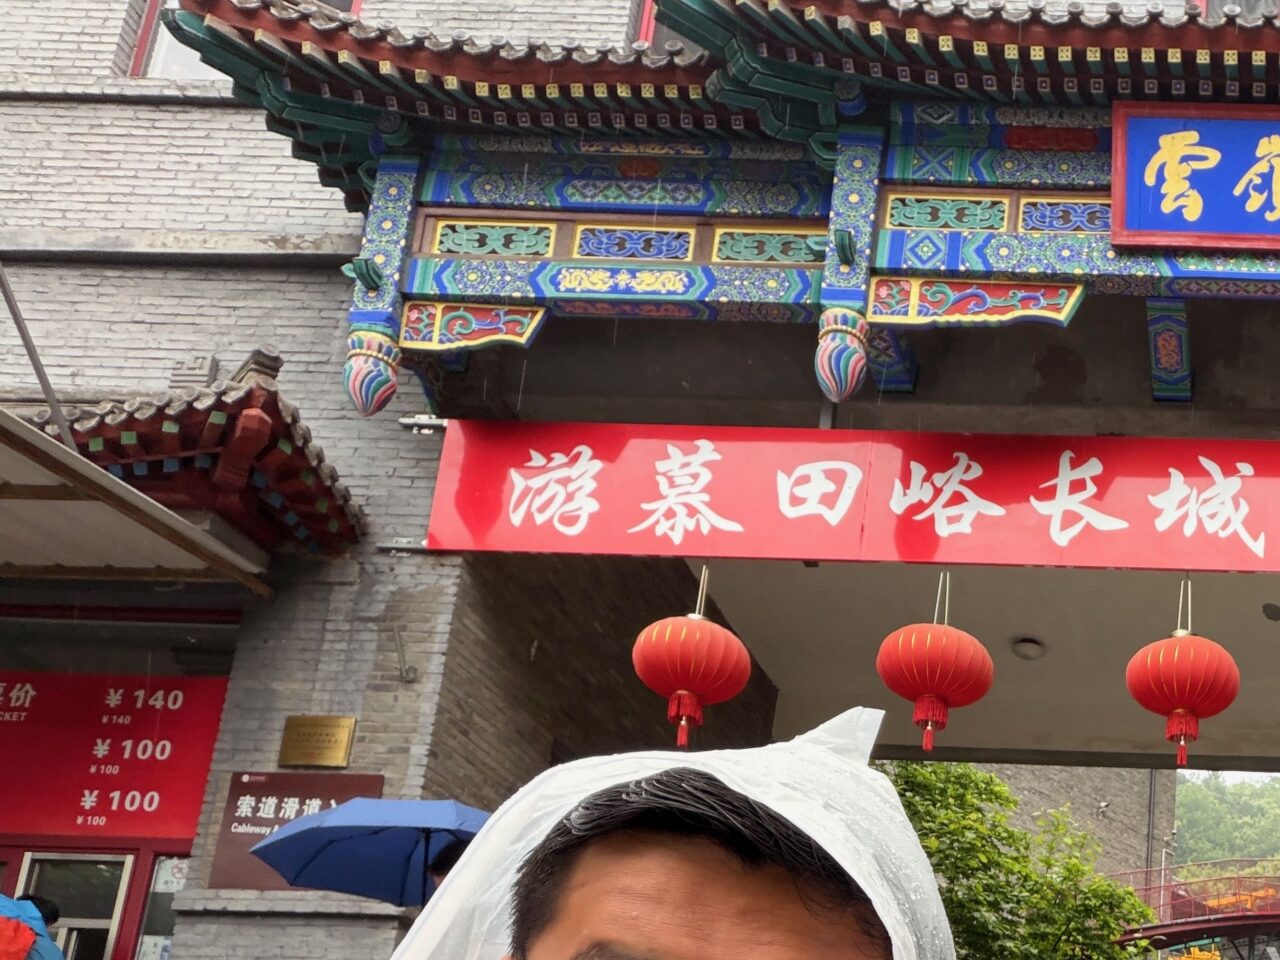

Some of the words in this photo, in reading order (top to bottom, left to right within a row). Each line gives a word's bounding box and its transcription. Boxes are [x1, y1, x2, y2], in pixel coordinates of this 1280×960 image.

[508, 438, 1265, 558] 游慕田峪长城
[0, 682, 37, 708] 价
[133, 689, 184, 710] 140
[121, 739, 172, 761] 100
[108, 790, 160, 812] 100
[235, 794, 337, 819] 索道滑道
[231, 822, 272, 835] Cableway
